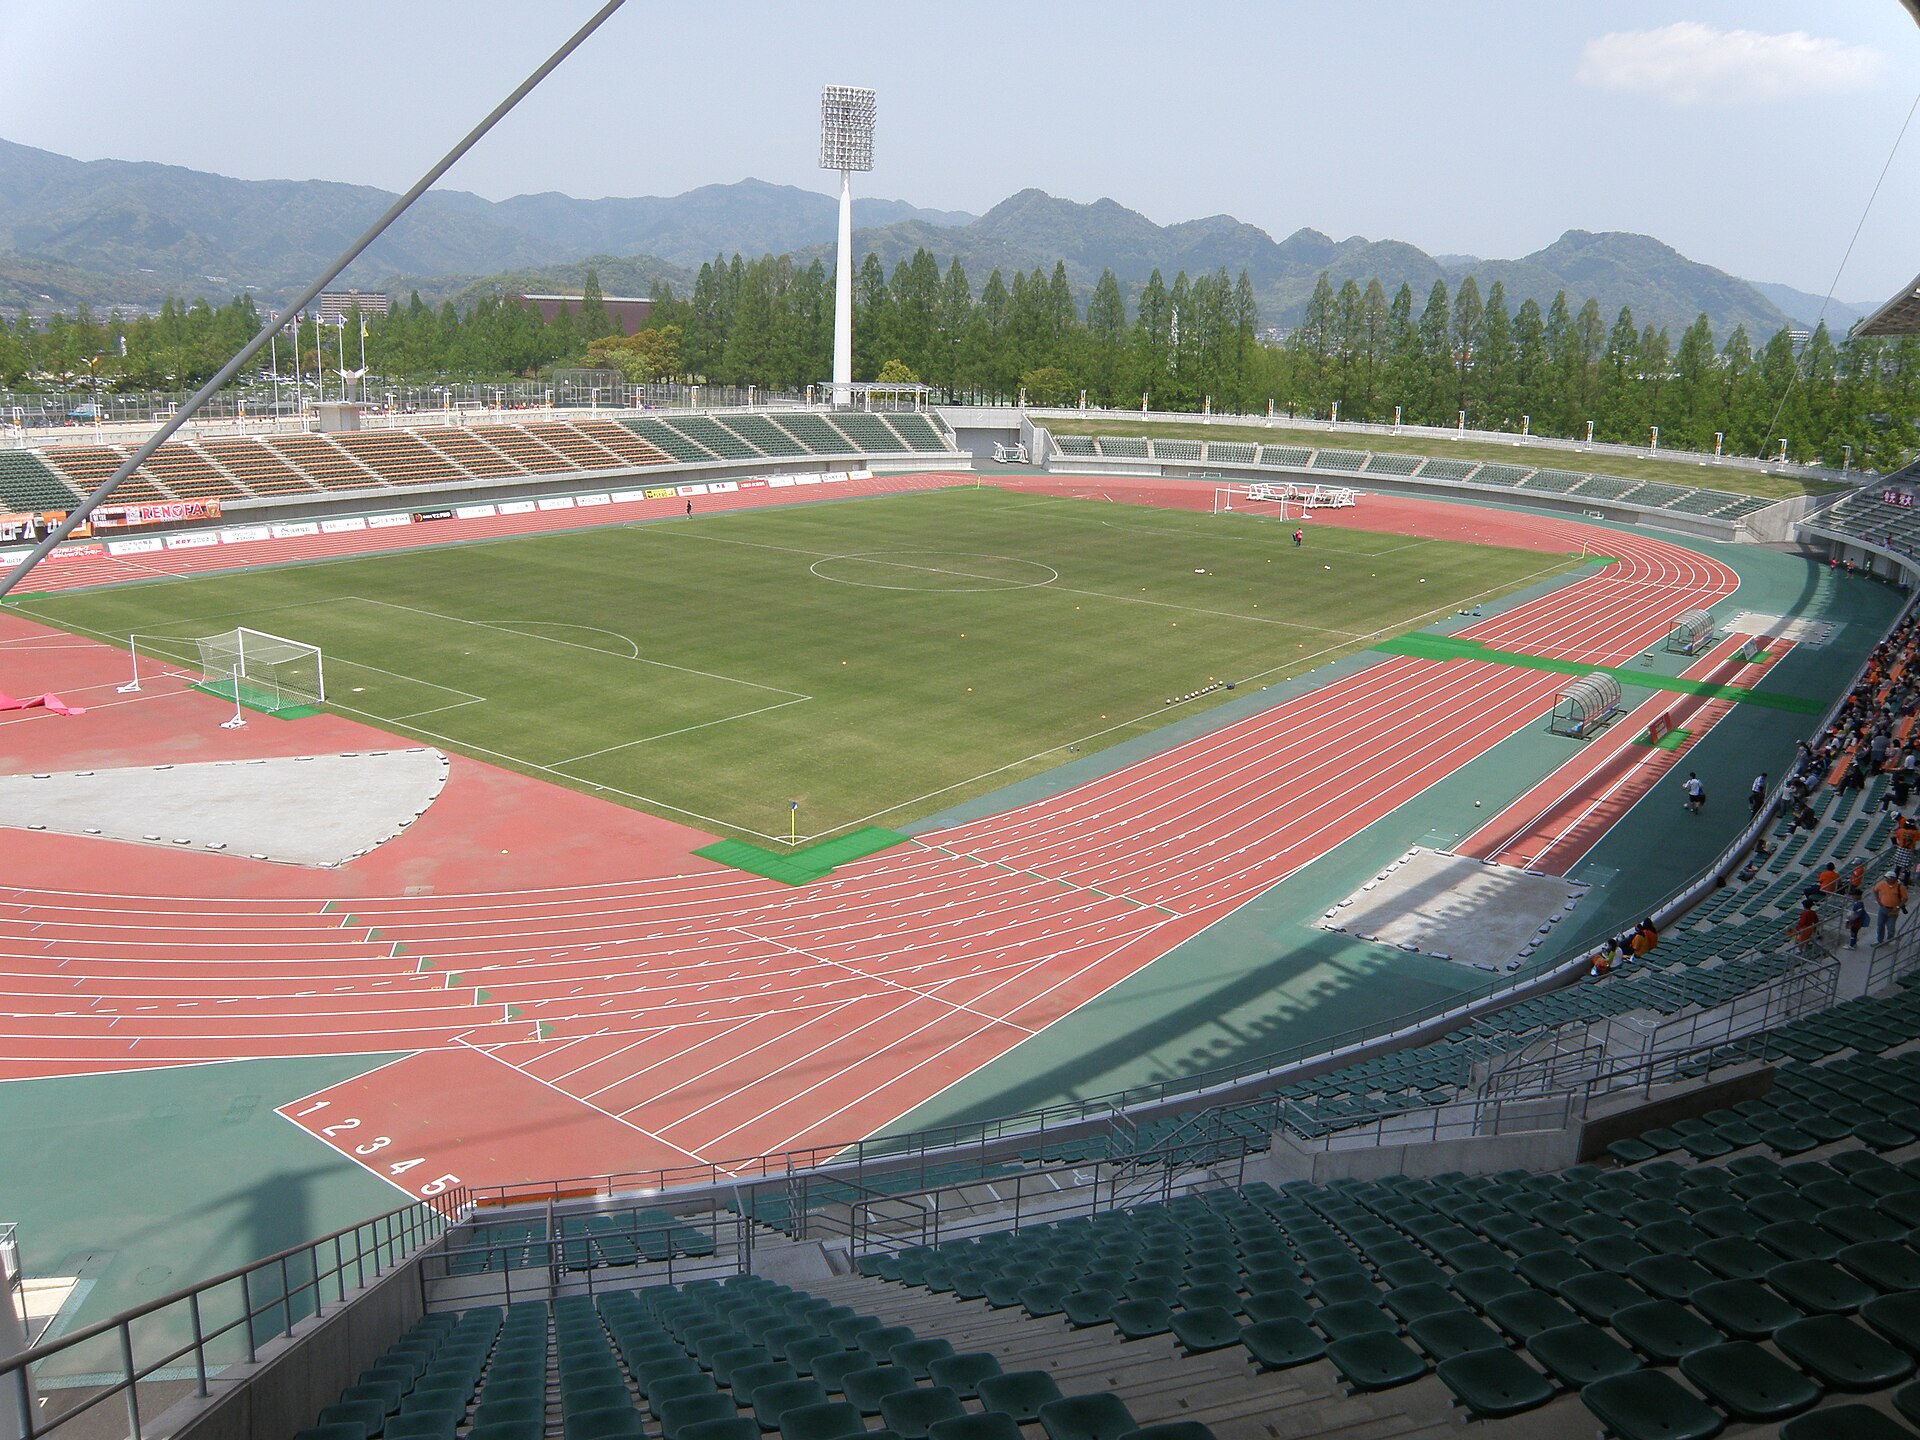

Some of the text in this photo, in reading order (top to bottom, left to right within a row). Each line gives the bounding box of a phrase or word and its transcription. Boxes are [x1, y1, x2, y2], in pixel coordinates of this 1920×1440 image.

[142, 503, 204, 520] RENOFA
[0, 519, 36, 541] OFA
[296, 1101, 331, 1117] 1
[321, 1118, 362, 1138] 2
[355, 1136, 392, 1155] 3
[390, 1157, 426, 1176] 4
[420, 1173, 461, 1195] 5
